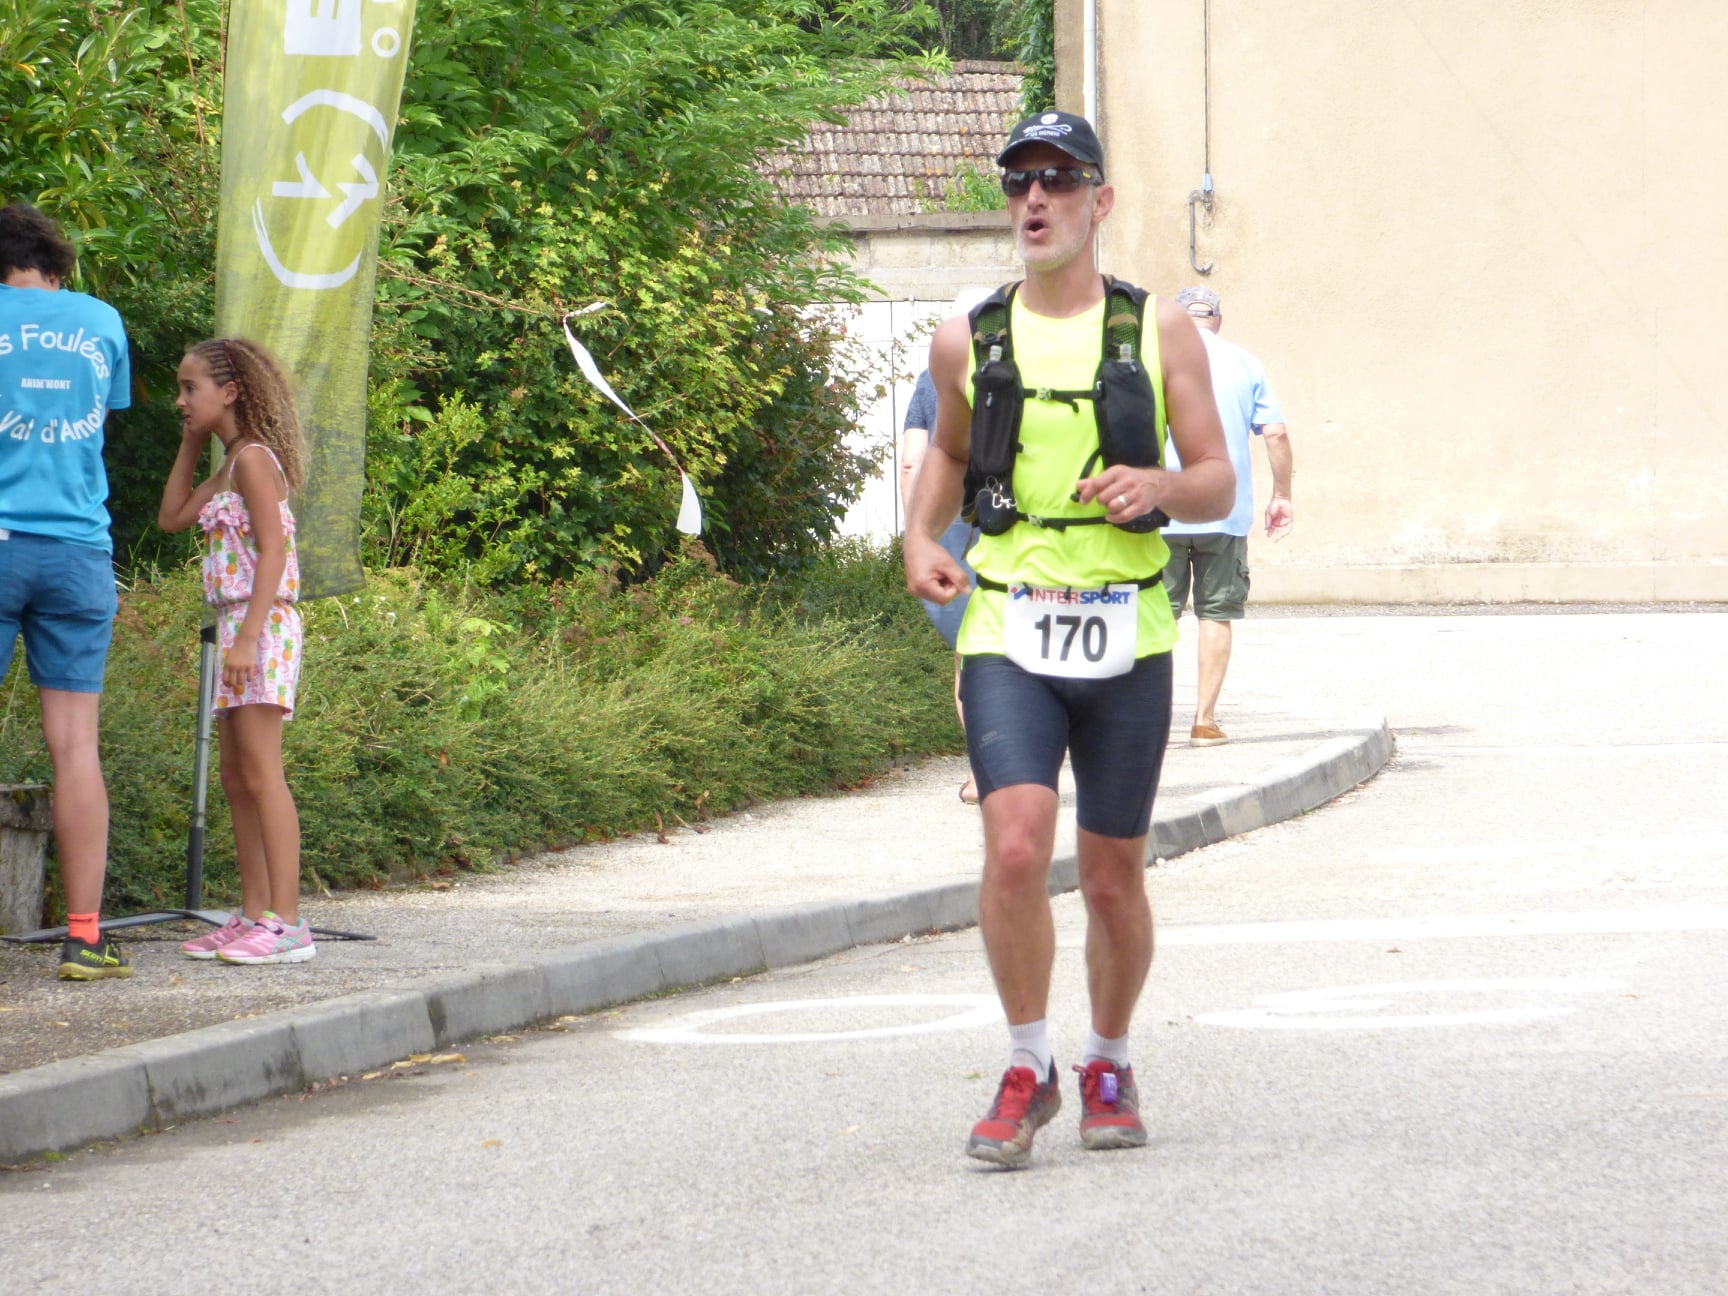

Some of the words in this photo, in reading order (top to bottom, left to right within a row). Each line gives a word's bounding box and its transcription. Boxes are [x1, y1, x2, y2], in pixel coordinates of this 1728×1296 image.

[20, 323, 110, 379] Foulées
[1031, 588, 1131, 605] INTERSPORT
[1034, 613, 1108, 663] 170
